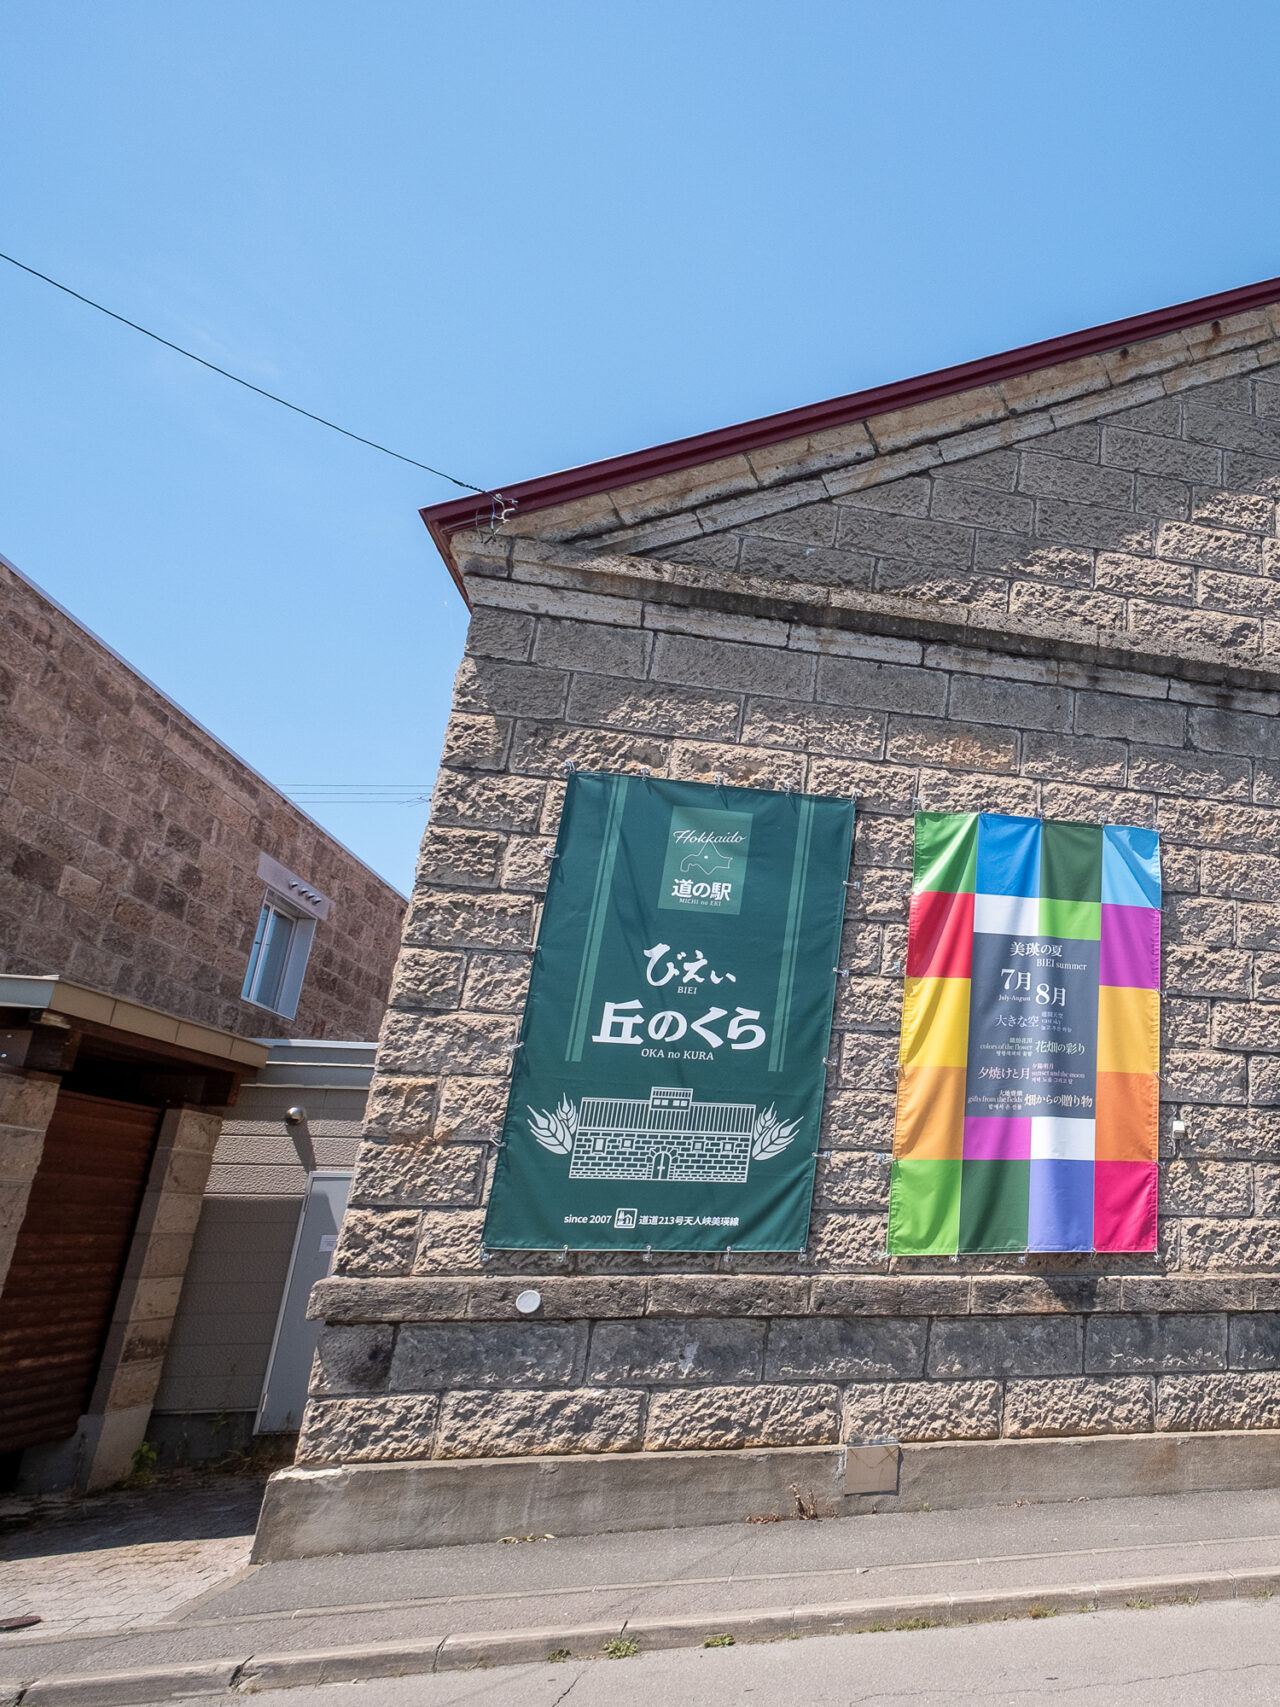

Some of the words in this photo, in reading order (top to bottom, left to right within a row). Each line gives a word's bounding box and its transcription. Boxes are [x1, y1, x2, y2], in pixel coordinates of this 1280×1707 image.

[673, 830, 746, 844] Hokkaido
[671, 878, 732, 901] 道の駅
[1009, 941, 1063, 957] 美瑛の夏
[1036, 958, 1055, 968] BIEI
[1056, 961, 1088, 971] summer
[677, 986, 698, 995] BIEI
[1000, 968, 1032, 991] 7月
[1035, 983, 1067, 1007] 8月
[592, 999, 766, 1050] 丘のくら
[994, 1014, 1040, 1028] 大きな空
[641, 1048, 665, 1059] OKA
[667, 1051, 681, 1059] no
[683, 1050, 714, 1061] KURA
[1035, 1040, 1086, 1055] 花畑の彩り
[978, 1066, 1030, 1080] 夕焼けと月
[1024, 1093, 1093, 1107] 畑からの贈り物
[564, 1214, 588, 1224] since
[589, 1215, 612, 1225] 2007
